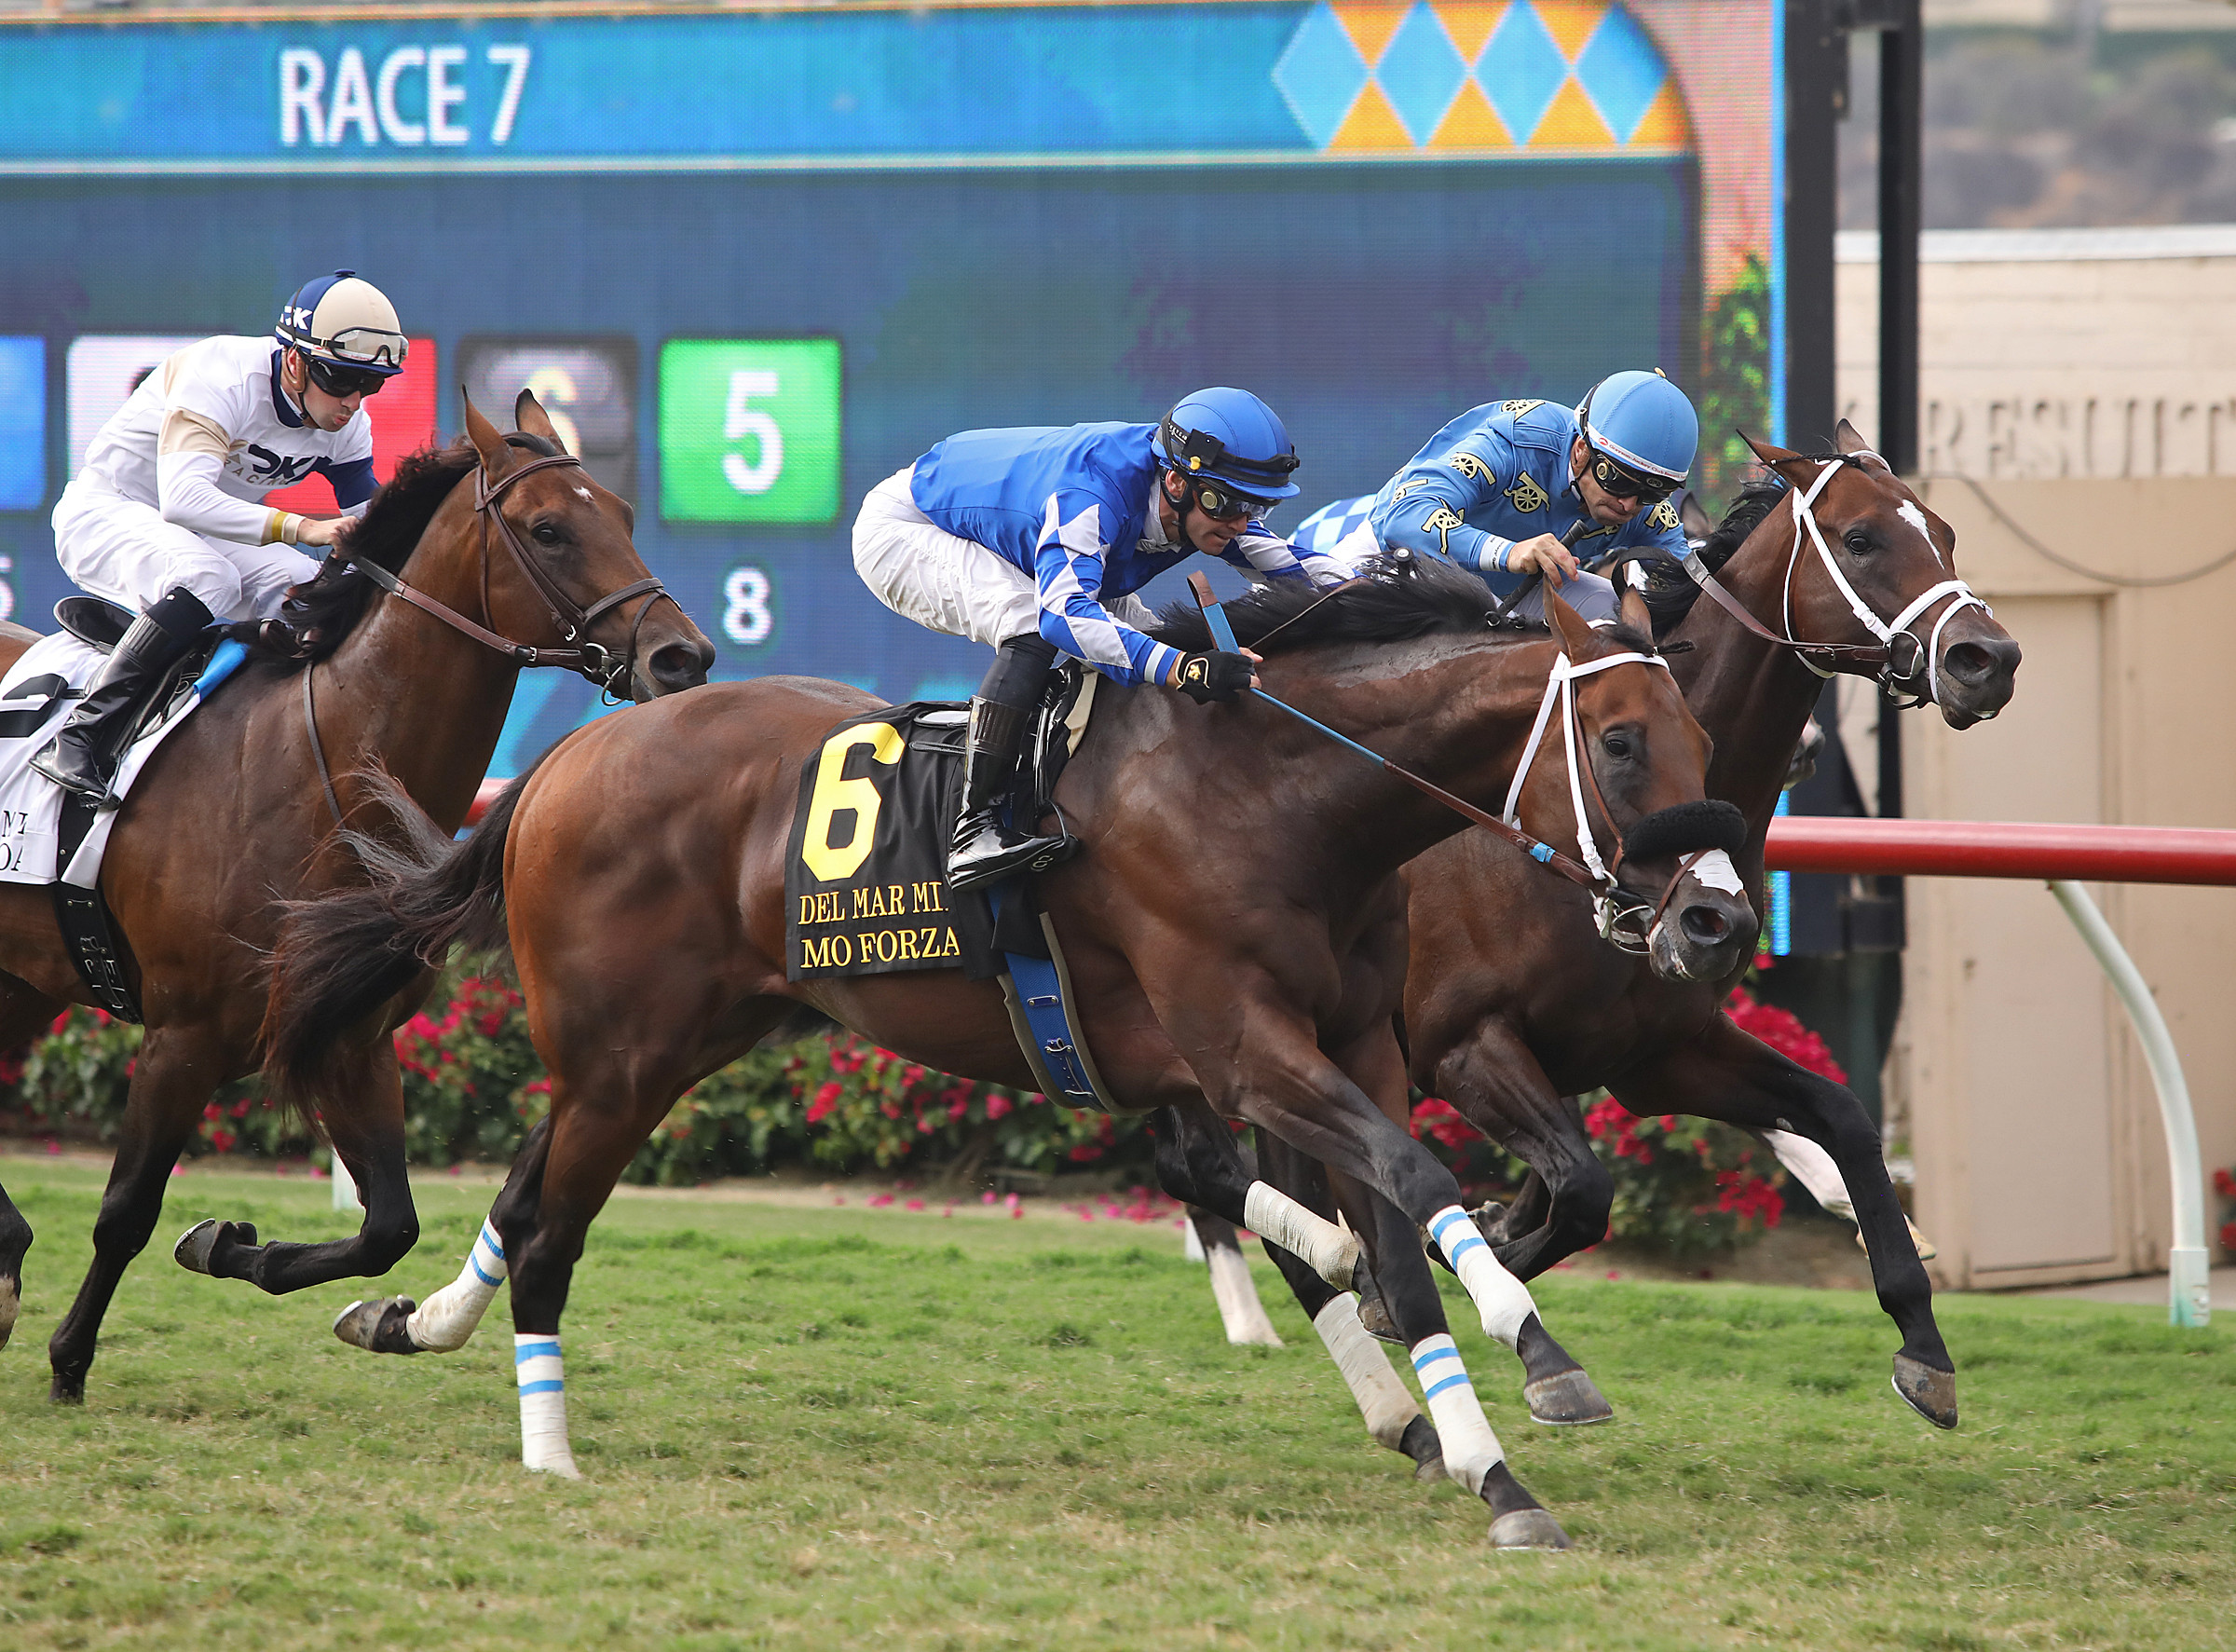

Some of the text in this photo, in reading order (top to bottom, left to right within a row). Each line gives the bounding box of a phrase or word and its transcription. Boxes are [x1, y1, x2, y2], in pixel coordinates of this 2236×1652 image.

[280, 45, 530, 146] RACE 7
[721, 368, 784, 494] 5
[722, 566, 775, 646] 8
[801, 721, 906, 882] 6
[798, 891, 846, 925] DEL
[852, 884, 906, 920] MAR
[799, 926, 961, 969] MO FORZA
